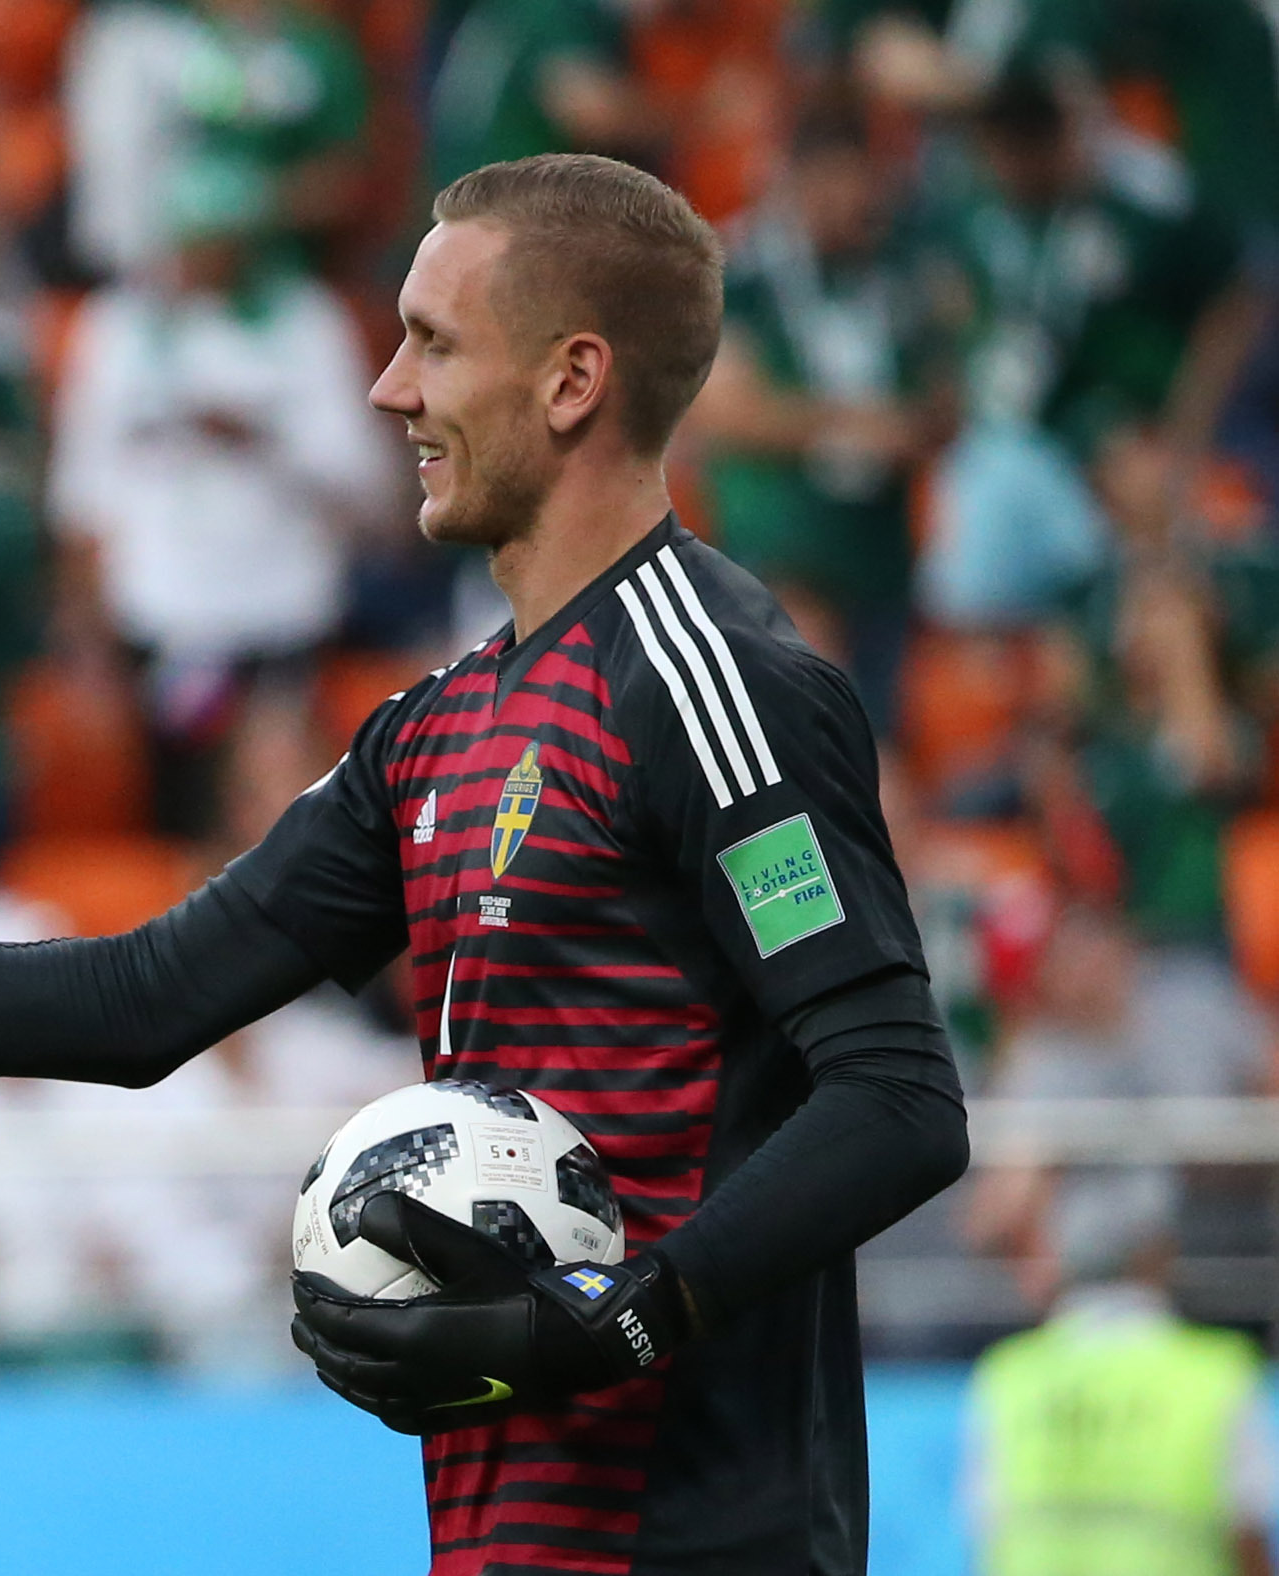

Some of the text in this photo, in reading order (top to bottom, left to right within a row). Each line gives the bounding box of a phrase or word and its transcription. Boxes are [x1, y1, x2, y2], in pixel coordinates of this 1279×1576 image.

[741, 850, 813, 891] LIVING
[794, 885, 826, 905] FIFA
[616, 1308, 655, 1366] OLSEN
